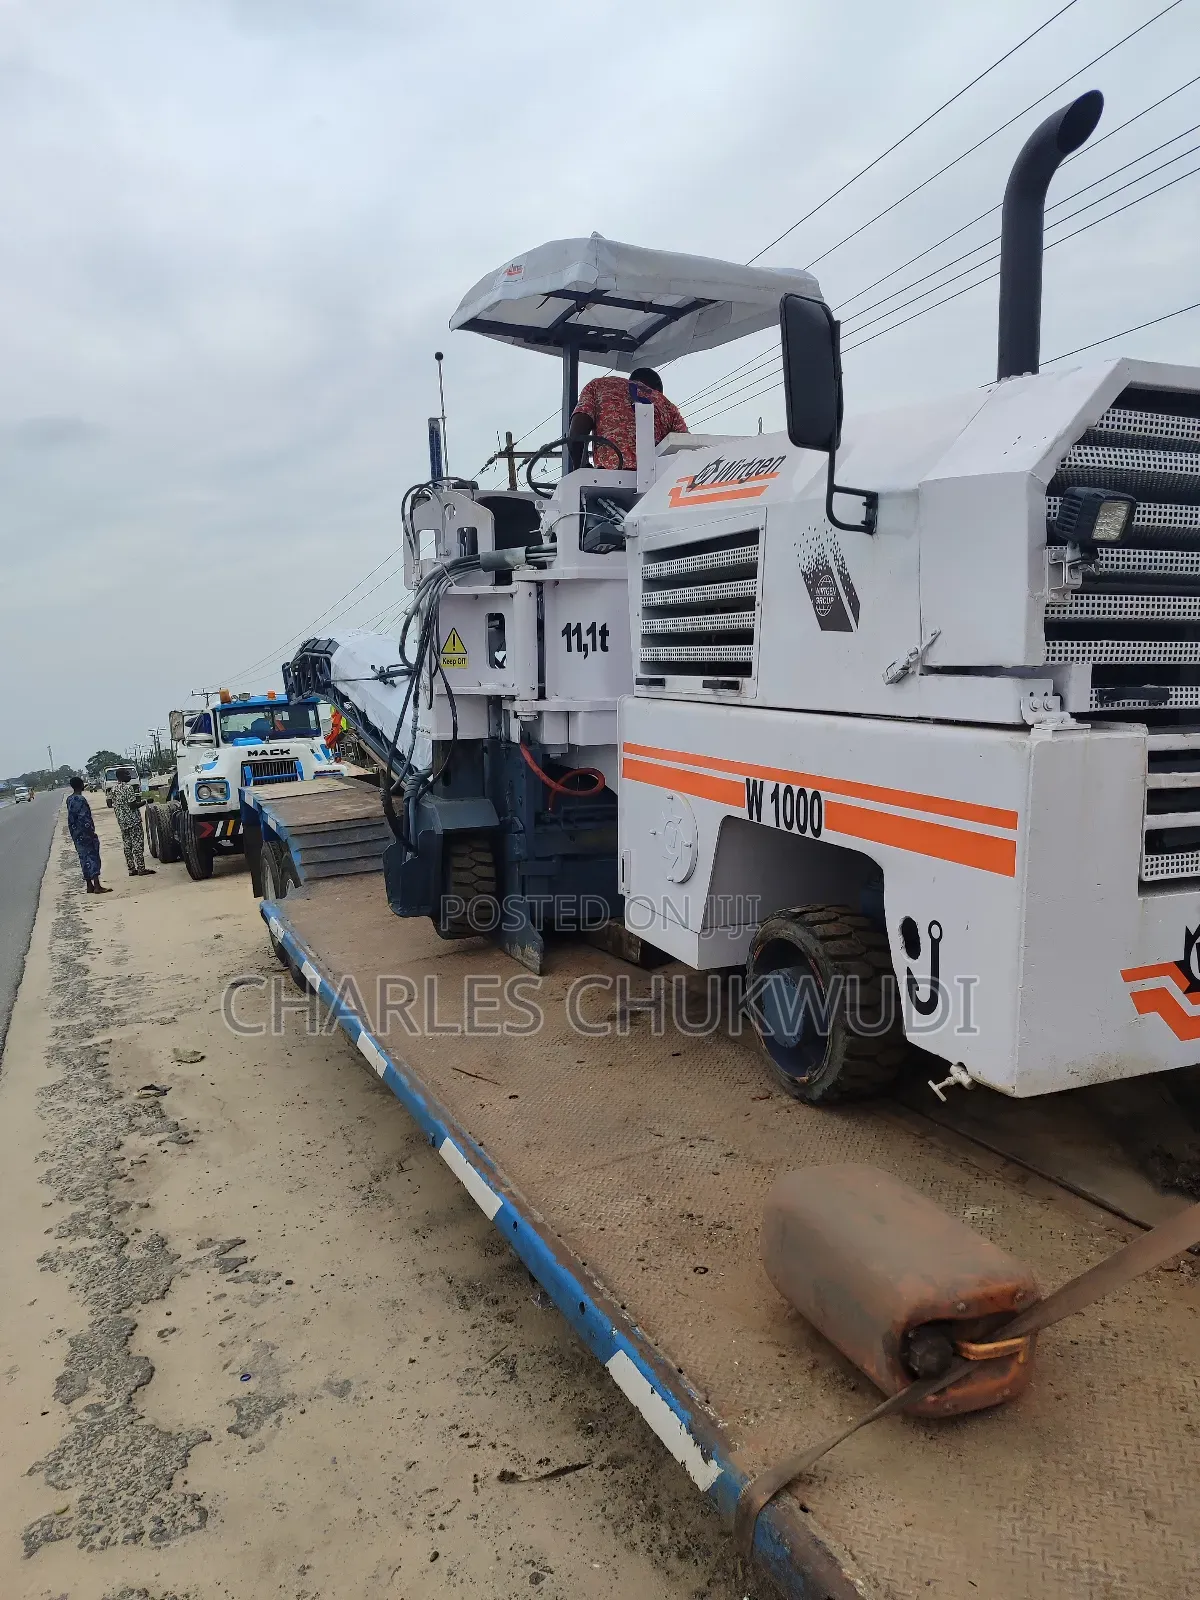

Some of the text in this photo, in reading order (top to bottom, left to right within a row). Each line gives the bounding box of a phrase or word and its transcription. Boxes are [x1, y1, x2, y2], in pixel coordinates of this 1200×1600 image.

[711, 455, 787, 484] Wirtgen
[561, 621, 610, 660] 11,1t
[442, 657, 457, 667] Keep
[247, 748, 291, 757] MACK
[745, 777, 823, 839] W 1000
